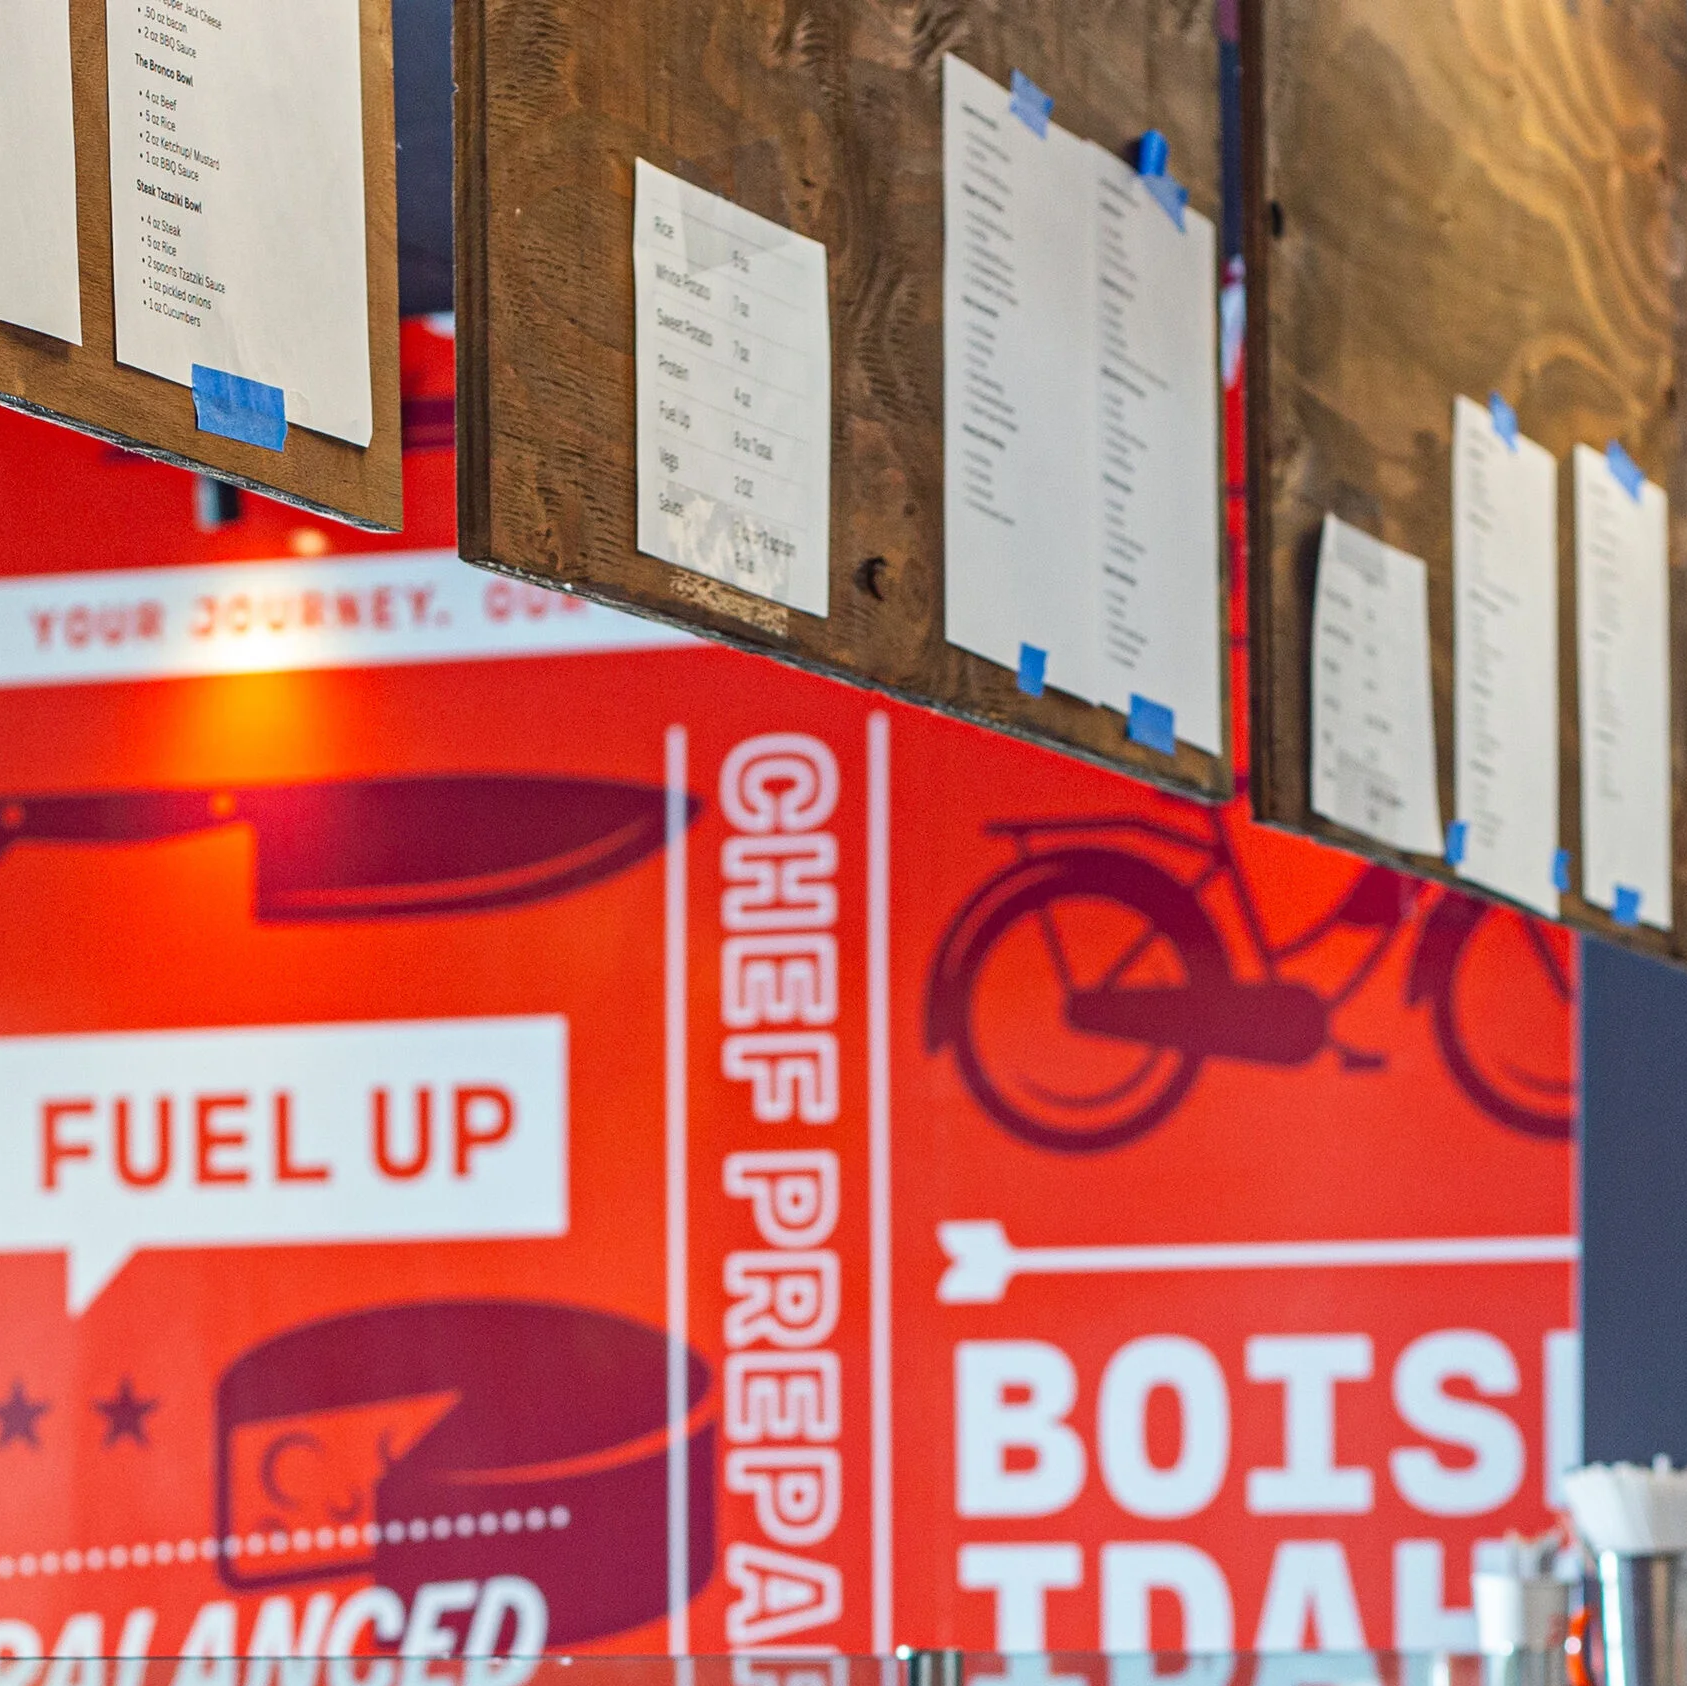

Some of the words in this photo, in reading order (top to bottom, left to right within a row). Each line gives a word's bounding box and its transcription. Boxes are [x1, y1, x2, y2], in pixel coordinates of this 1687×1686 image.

[166, 15, 189, 34] bacon
[144, 26, 149, 39] 2
[150, 31, 158, 43] oz
[159, 33, 175, 51] BBQ
[176, 40, 197, 58] Sauce
[135, 52, 148, 68] The
[149, 59, 174, 79] Bronco
[176, 70, 194, 87] Bowl
[145, 89, 150, 100] 4
[151, 94, 159, 105] oz
[161, 95, 177, 111] Beef
[145, 110, 150, 121] 5
[151, 114, 159, 126] oz
[161, 116, 176, 132] Rice
[145, 131, 150, 143] 2
[151, 136, 159, 146] oz
[151, 155, 159, 167] oz
[160, 157, 176, 175] BBQ
[178, 163, 199, 181] Sauce
[136, 179, 155, 197] Steak
[157, 187, 183, 207] Tzatziki
[184, 197, 202, 214] Bowl
[147, 215, 151, 225] 4
[152, 219, 160, 230] oz
[162, 220, 181, 237] Steak
[147, 235, 152, 247] 5
[153, 240, 161, 251] oz
[162, 241, 177, 256] Rice
[147, 255, 152, 268] 2
[153, 261, 177, 278] spoons
[179, 267, 204, 286] Tzatziki
[205, 276, 225, 294] Sauce
[154, 281, 162, 292] oz
[162, 282, 186, 301] pickled
[187, 293, 212, 310] onions
[154, 302, 162, 313] oz
[163, 303, 201, 327] Cucumbers
[28, 600, 166, 651] YOUR
[718, 732, 839, 1124] CHEF
[40, 1088, 330, 1192] FUEL
[369, 1083, 515, 1184] UP
